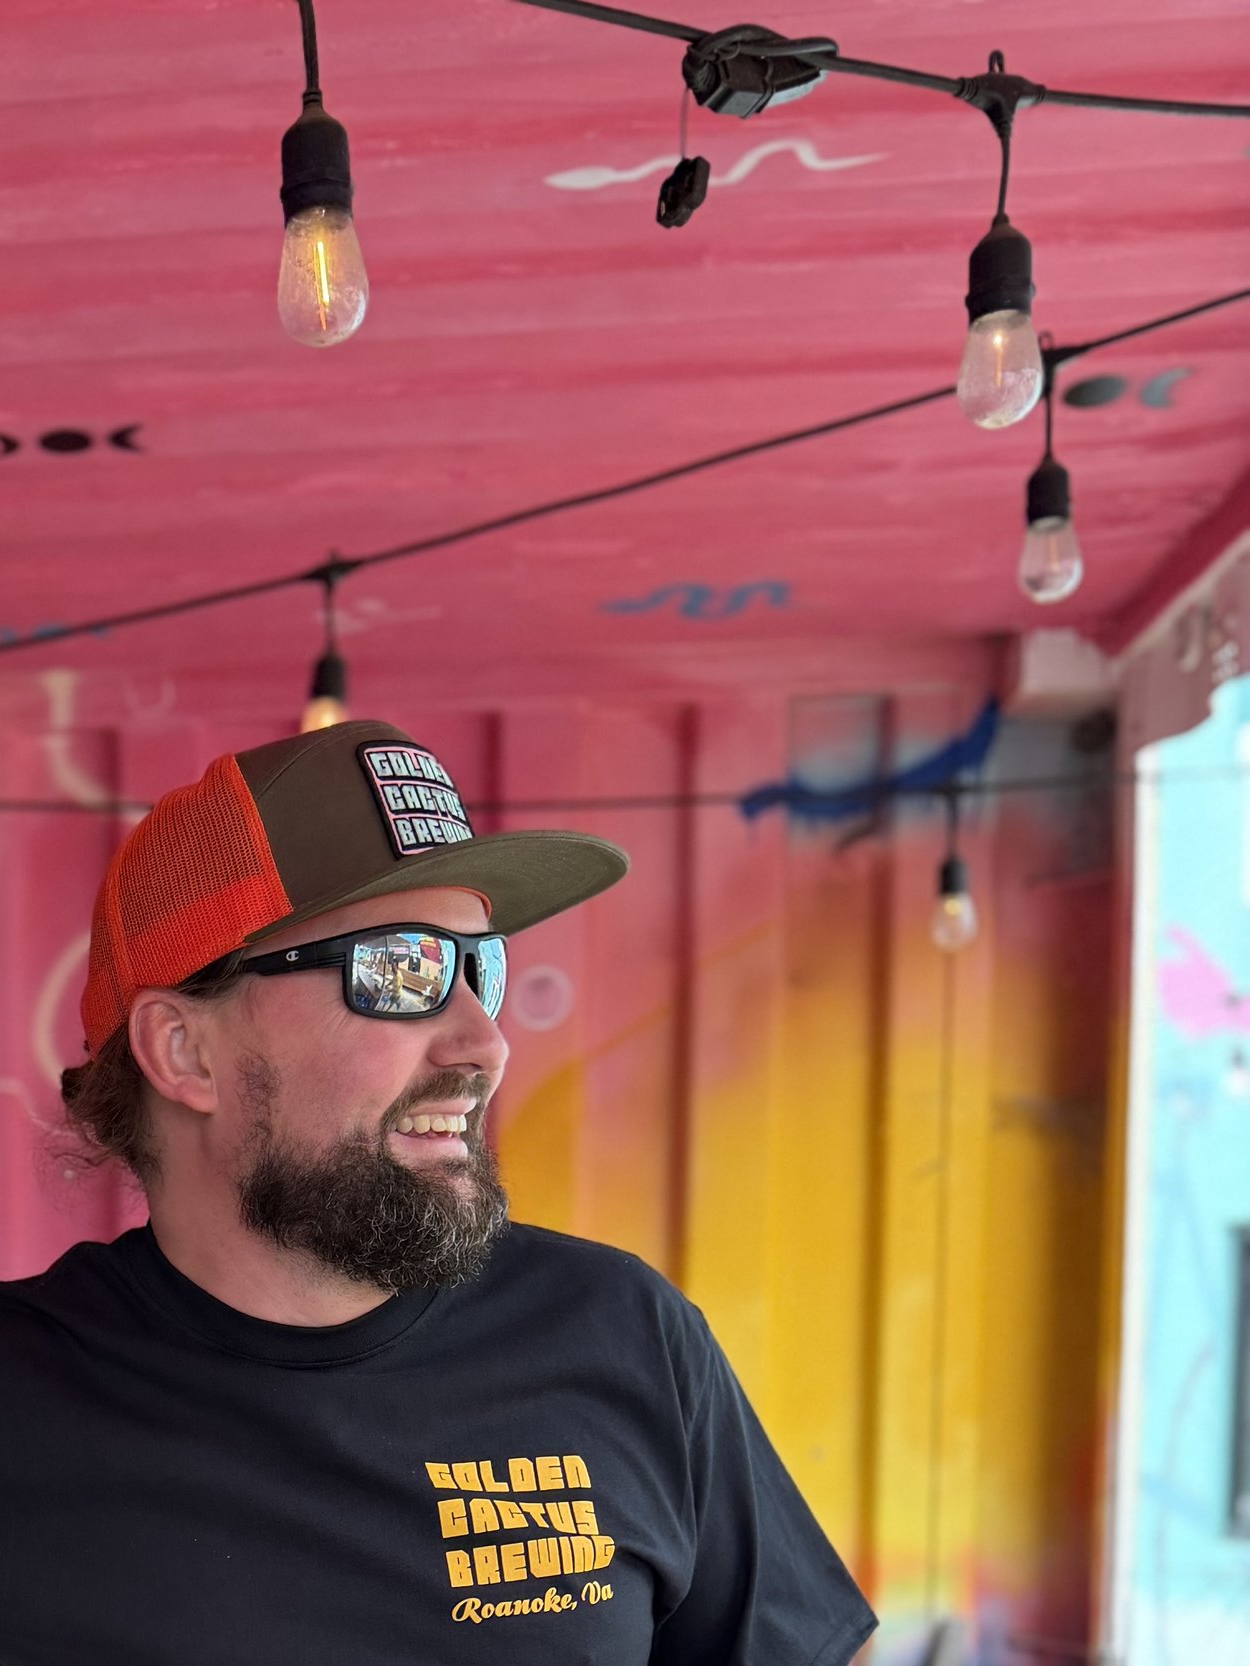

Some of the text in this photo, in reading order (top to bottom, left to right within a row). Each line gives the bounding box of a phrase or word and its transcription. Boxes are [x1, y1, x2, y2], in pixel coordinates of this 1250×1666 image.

[383, 784, 466, 821] CACTUS
[395, 818, 473, 846] BREWIN
[424, 1455, 592, 1492] GOLDEN
[437, 1498, 599, 1539] CACTUS
[446, 1535, 615, 1588] BREWING
[451, 1580, 614, 1624] Roanoke, Va
